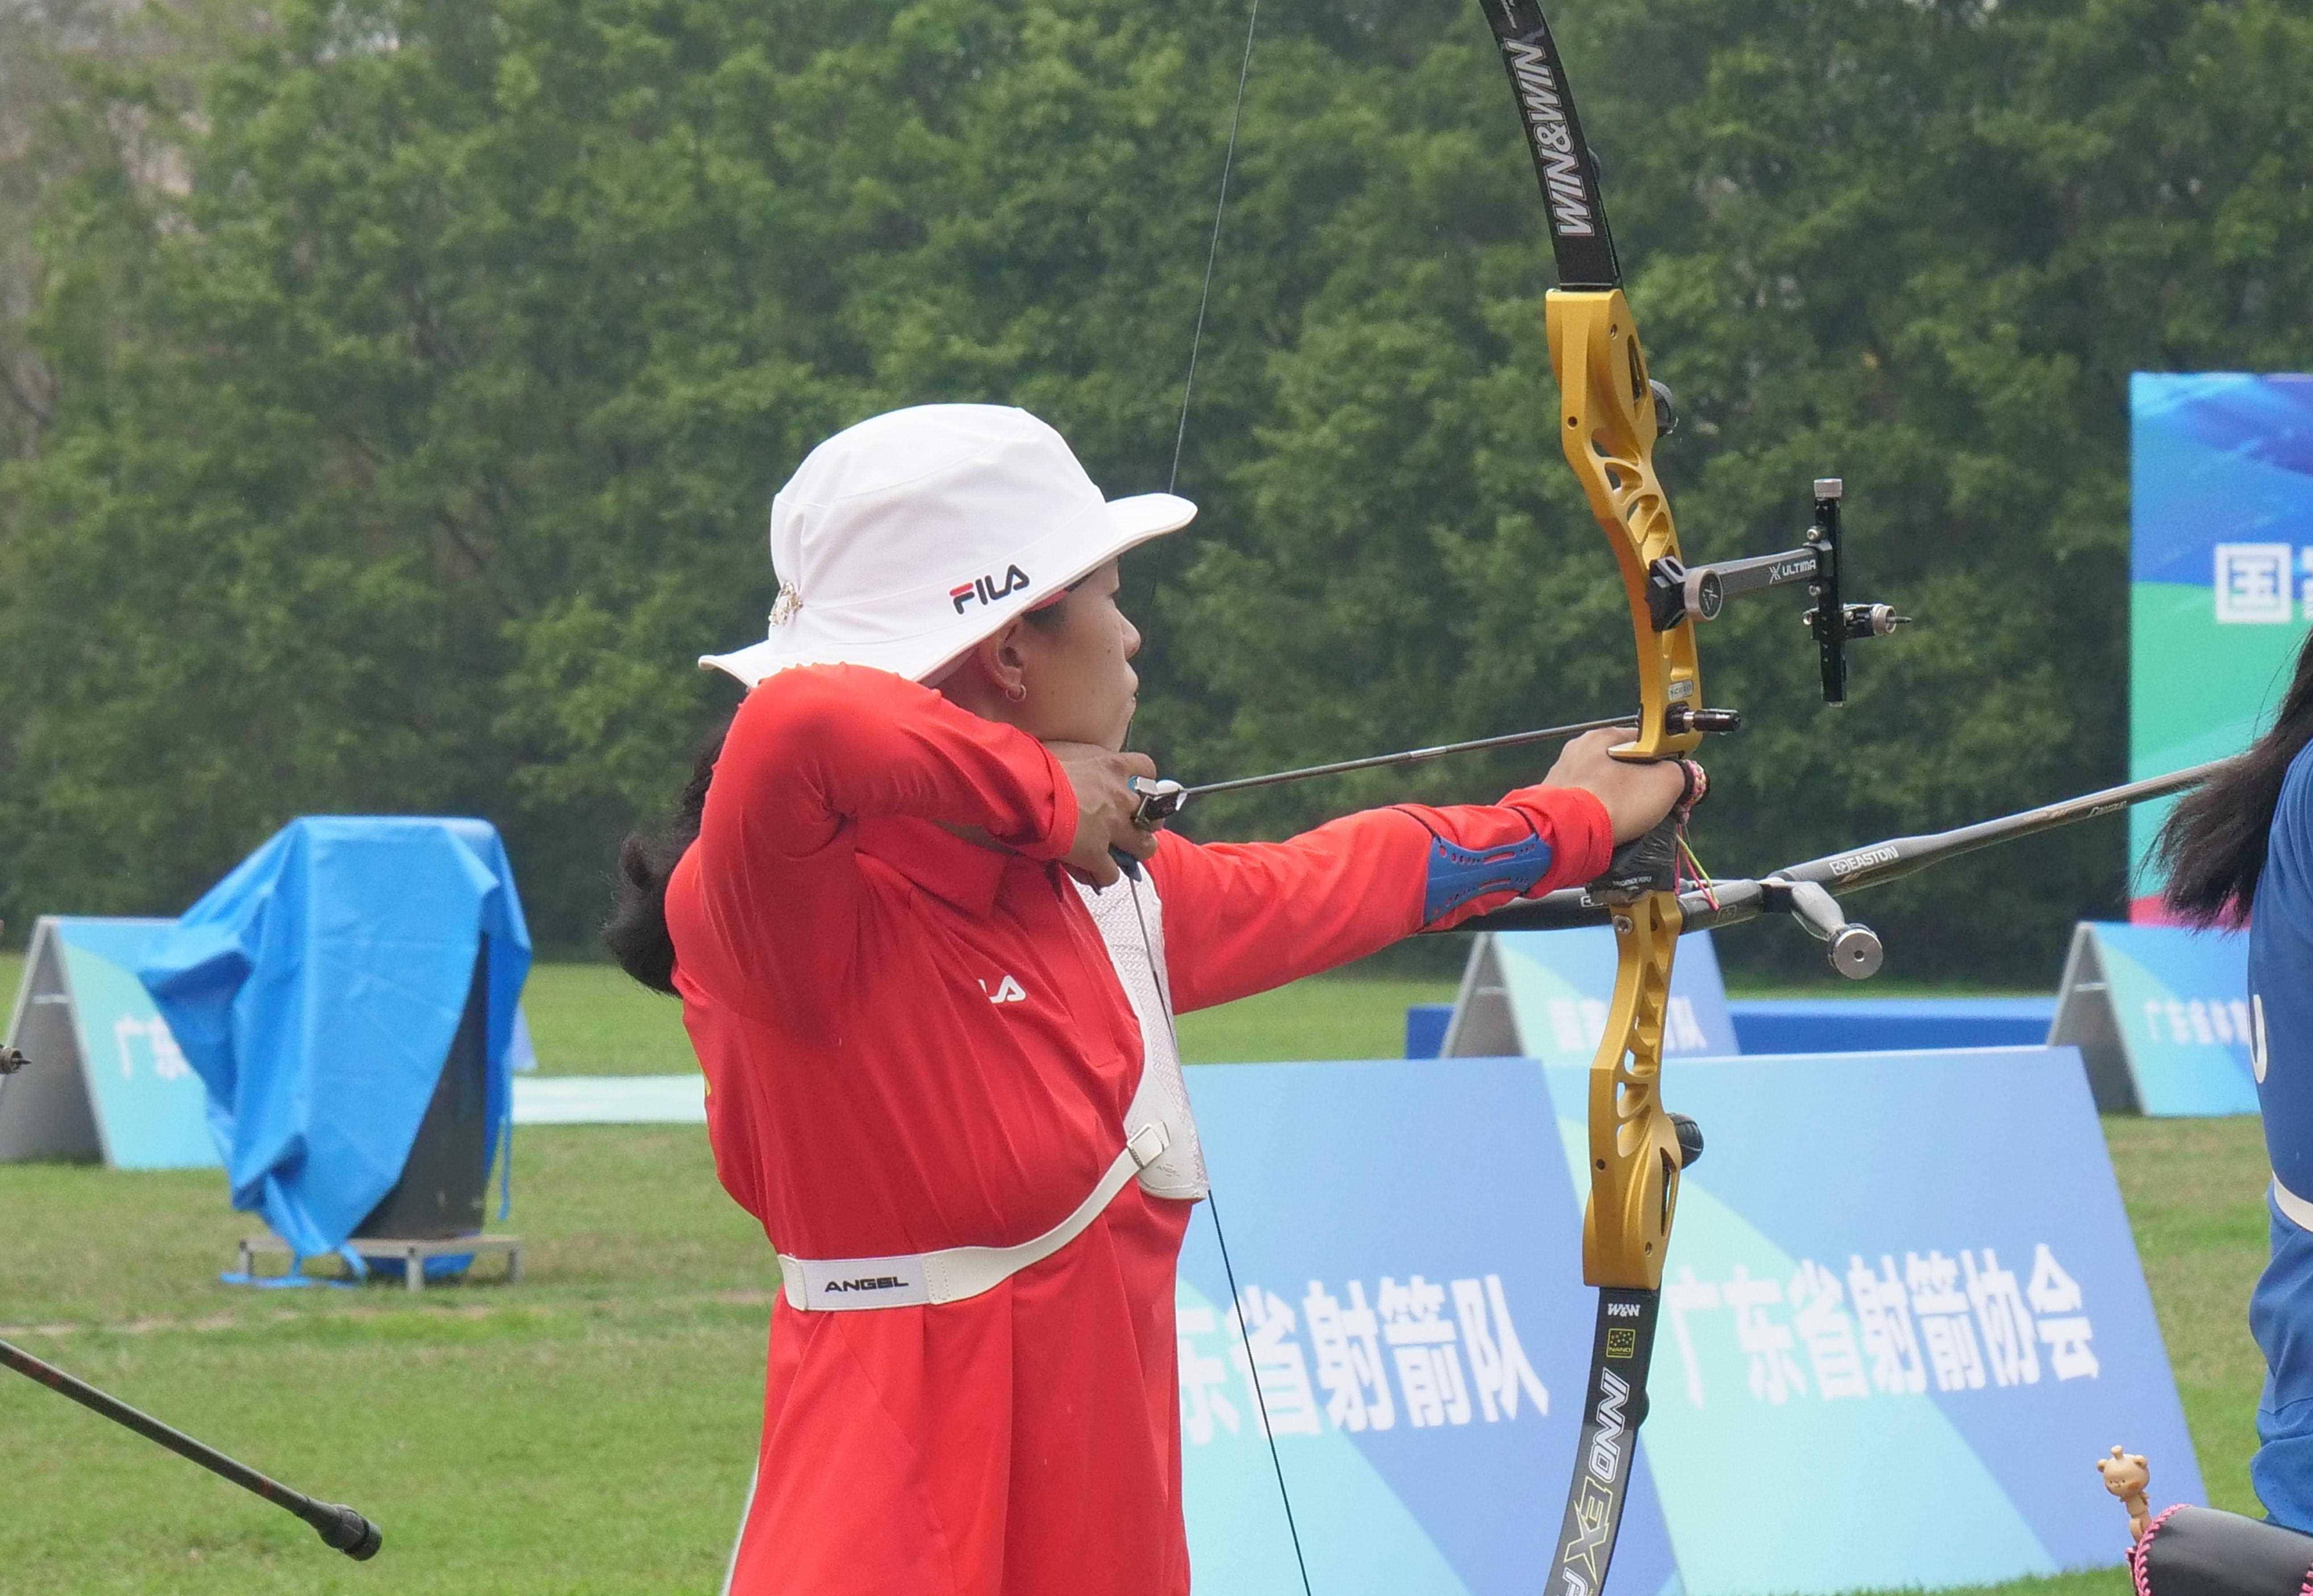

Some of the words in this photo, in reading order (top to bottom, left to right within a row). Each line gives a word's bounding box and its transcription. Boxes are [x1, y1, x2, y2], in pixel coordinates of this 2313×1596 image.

[1503, 37, 1595, 236] WIN&WIN
[949, 564, 1030, 614] FILA
[1782, 559, 1816, 576] ULTIMA
[1846, 846, 1899, 871] EASTON
[978, 974, 1026, 1003] LA
[825, 1276, 909, 1292] ANGEL
[1666, 1242, 2099, 1411] 广东省射箭协会
[1589, 1366, 1630, 1484] INNO
[1563, 1476, 1613, 1585] EX
